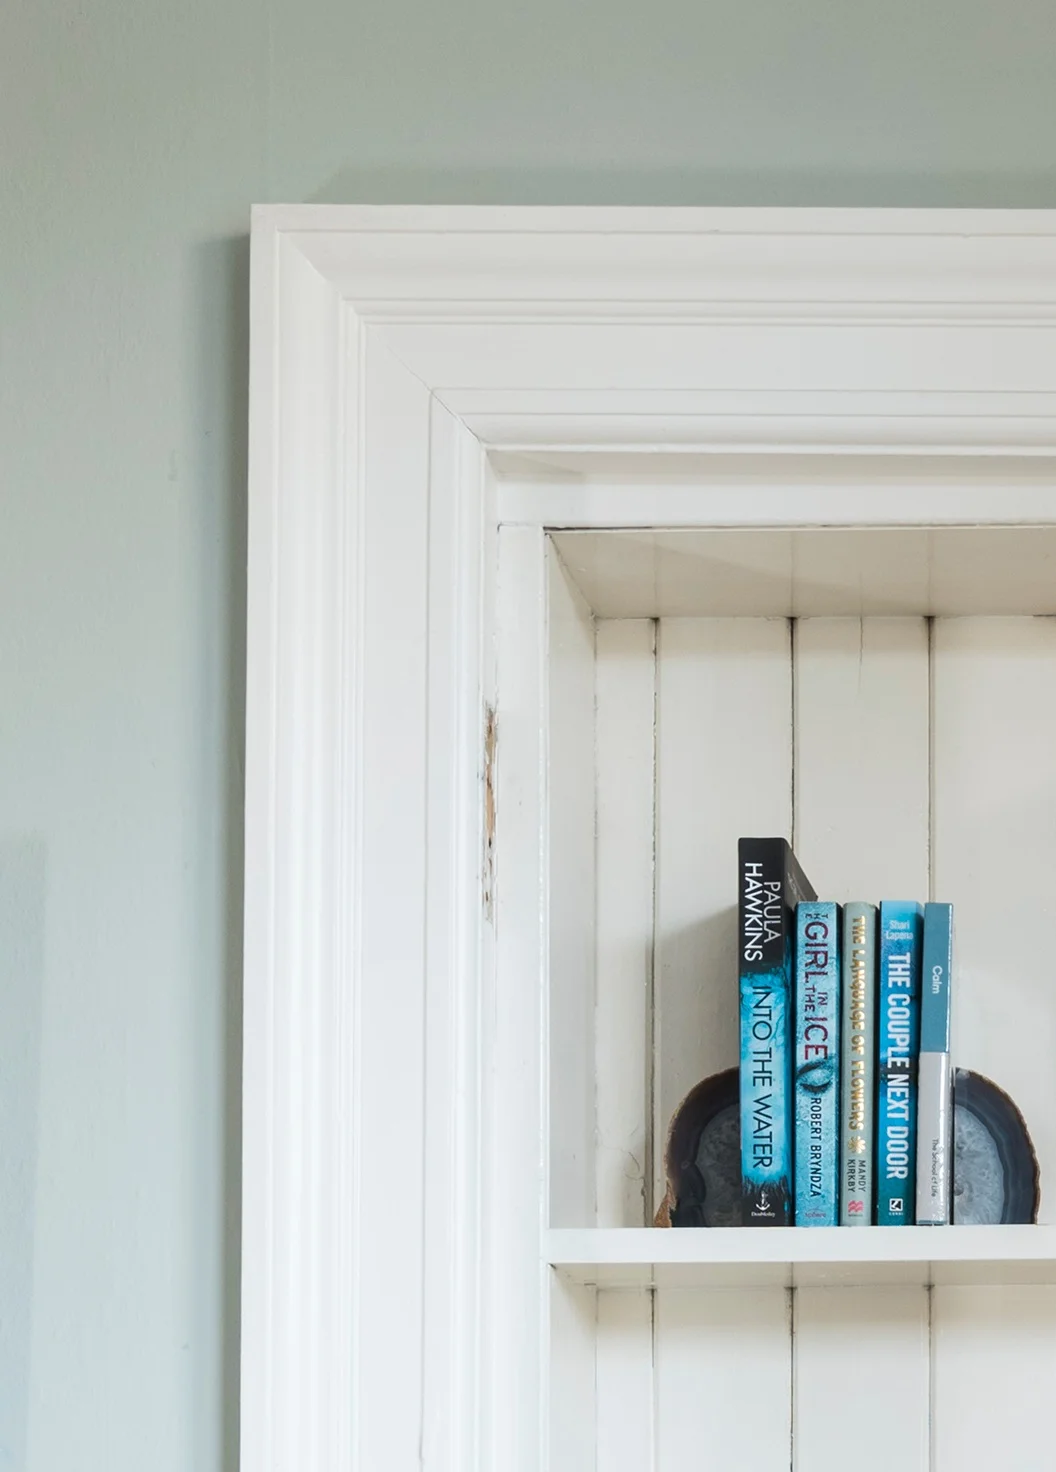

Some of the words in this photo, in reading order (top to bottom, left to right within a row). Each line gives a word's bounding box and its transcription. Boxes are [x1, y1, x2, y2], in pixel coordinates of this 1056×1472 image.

[744, 863, 763, 961] HAWKINS
[763, 882, 780, 942] PAULA
[851, 915, 866, 944] THE
[804, 921, 829, 984] GIRL
[887, 952, 911, 988] THE
[804, 984, 815, 1012] THE
[817, 992, 828, 1006] IN
[849, 949, 866, 1031] LANGUAGE
[932, 965, 943, 994] Calm
[753, 986, 772, 1040] INTO
[886, 993, 911, 1068] COUPLE
[804, 1016, 829, 1060] ICE
[851, 1035, 865, 1056] OF
[753, 1047, 772, 1086] THE
[849, 1060, 864, 1130] FLOWERS
[886, 1074, 910, 1122] NEXT
[753, 1093, 772, 1168] WATER
[810, 1097, 822, 1141] ROBERT
[810, 1145, 822, 1197] BRYNDZA
[885, 1125, 909, 1179] DOOR
[847, 1159, 857, 1192] KIRKBY
[857, 1159, 866, 1192] MANDY
